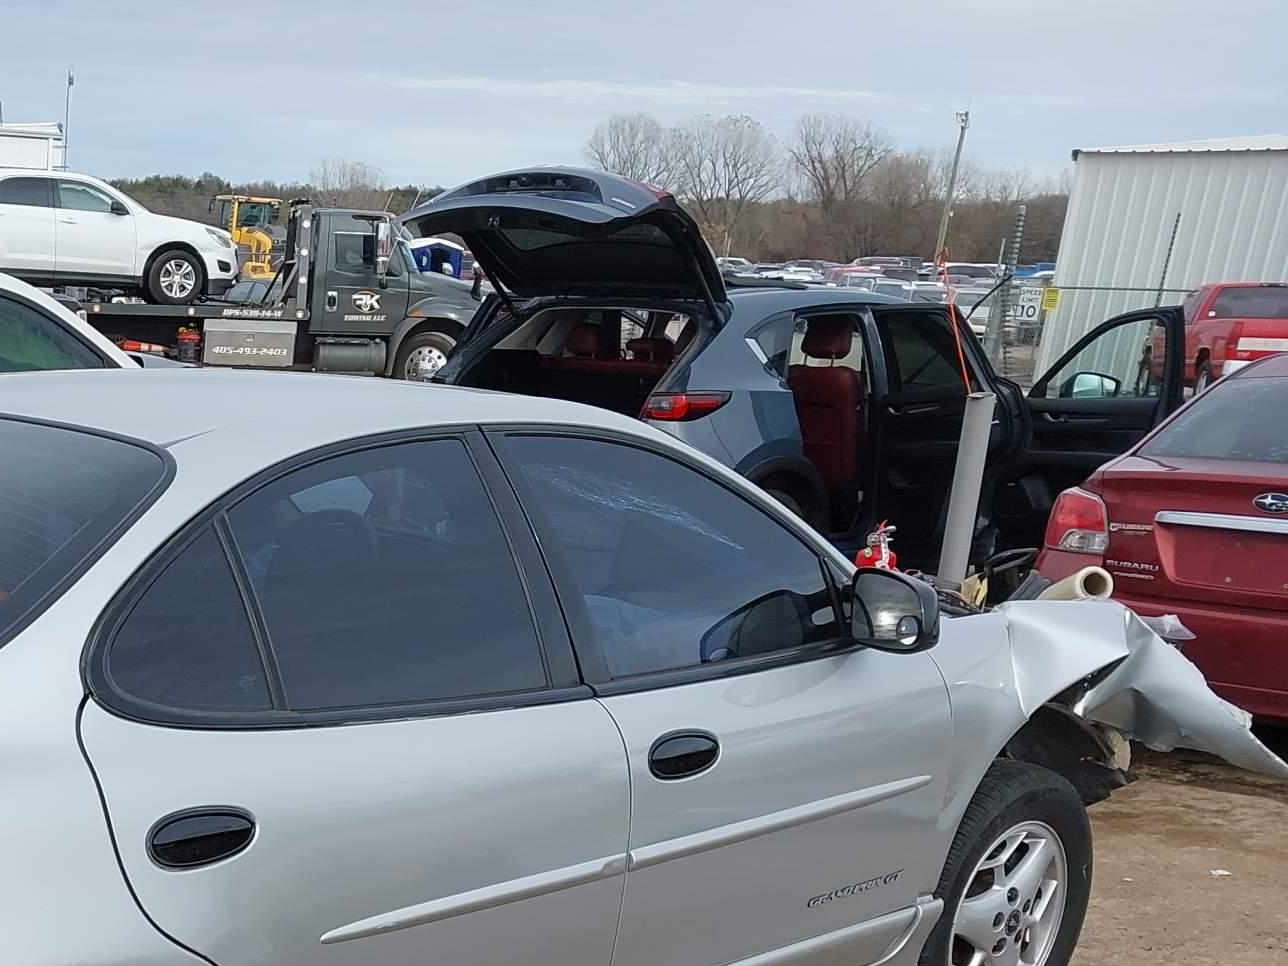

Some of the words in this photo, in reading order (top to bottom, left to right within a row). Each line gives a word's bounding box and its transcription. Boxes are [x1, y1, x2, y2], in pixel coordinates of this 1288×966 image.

[1020, 304, 1037, 318] 10
[344, 314, 372, 322] TOWING
[372, 314, 387, 322] LLC
[212, 345, 288, 357] 405-493-2403
[1106, 559, 1160, 572] SUBARU
